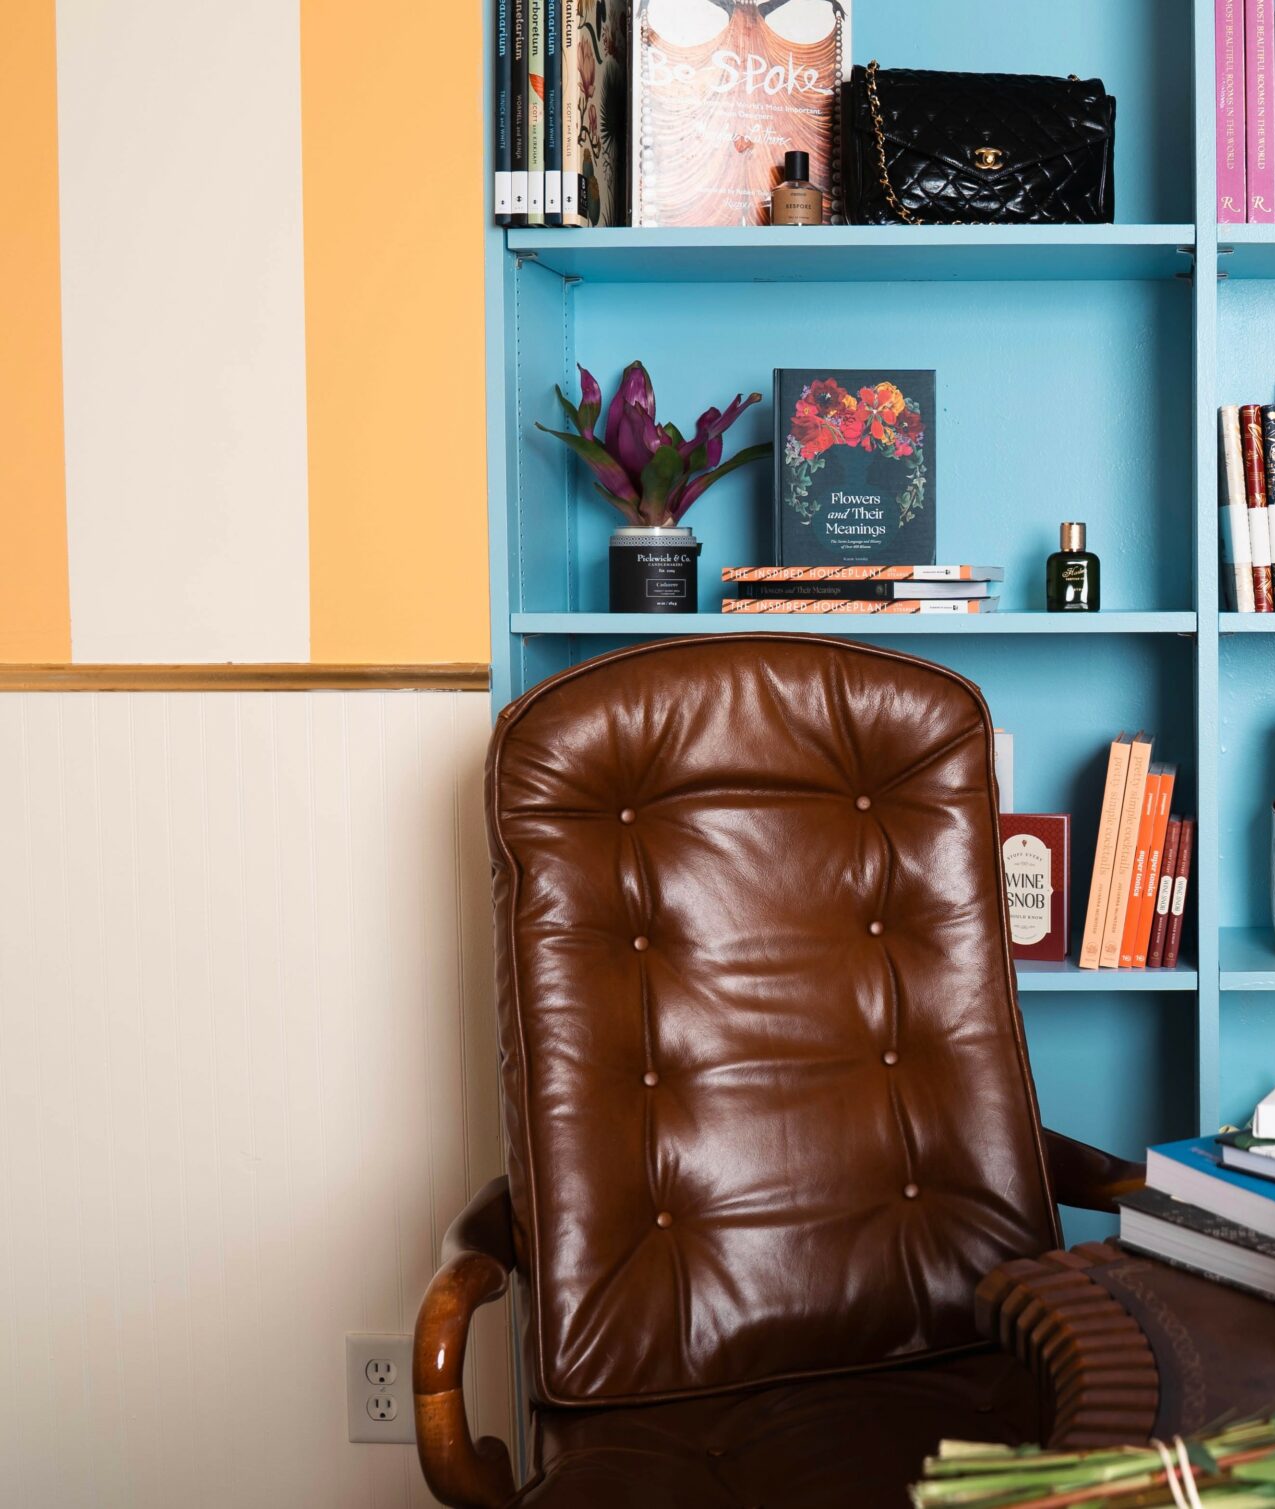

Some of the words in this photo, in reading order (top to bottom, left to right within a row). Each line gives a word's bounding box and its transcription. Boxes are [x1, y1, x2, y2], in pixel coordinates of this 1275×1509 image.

[1225, 26, 1233, 72] BEAUTIFUL
[1256, 26, 1265, 72] BEAUTIFUL
[1226, 74, 1234, 105] ROOMS
[1257, 74, 1265, 105] ROOMS
[1226, 107, 1234, 117] IN
[1257, 107, 1265, 117] IN
[1226, 119, 1234, 136] THE
[1257, 119, 1265, 136] THE
[1226, 138, 1235, 170] WORLD
[1257, 138, 1266, 170] WORLD
[831, 491, 881, 505] Flowers
[827, 508, 851, 519] and
[852, 506, 884, 519] Their
[825, 523, 886, 537] Meanings
[636, 553, 672, 562] Pickwick
[673, 554, 680, 562] &
[729, 570, 749, 579] THE
[754, 569, 804, 578] INSPIRED
[809, 567, 882, 578] HOUSEPLANT
[731, 602, 749, 611] THE
[756, 601, 807, 611] INSPIRED
[813, 602, 888, 611] HOUSEPLANT
[1105, 791, 1119, 826] simple
[1125, 790, 1139, 825] simple
[1100, 828, 1114, 876] cocktails
[1119, 827, 1133, 876] cocktails
[1137, 850, 1145, 873] super
[1150, 850, 1159, 873] super
[1005, 872, 1044, 889] WINE
[1133, 873, 1143, 897] tonics
[1147, 873, 1156, 897] tonics
[1007, 891, 1045, 909] SNOB
[1160, 894, 1168, 911] SNOB
[1174, 895, 1183, 912] SNOB
